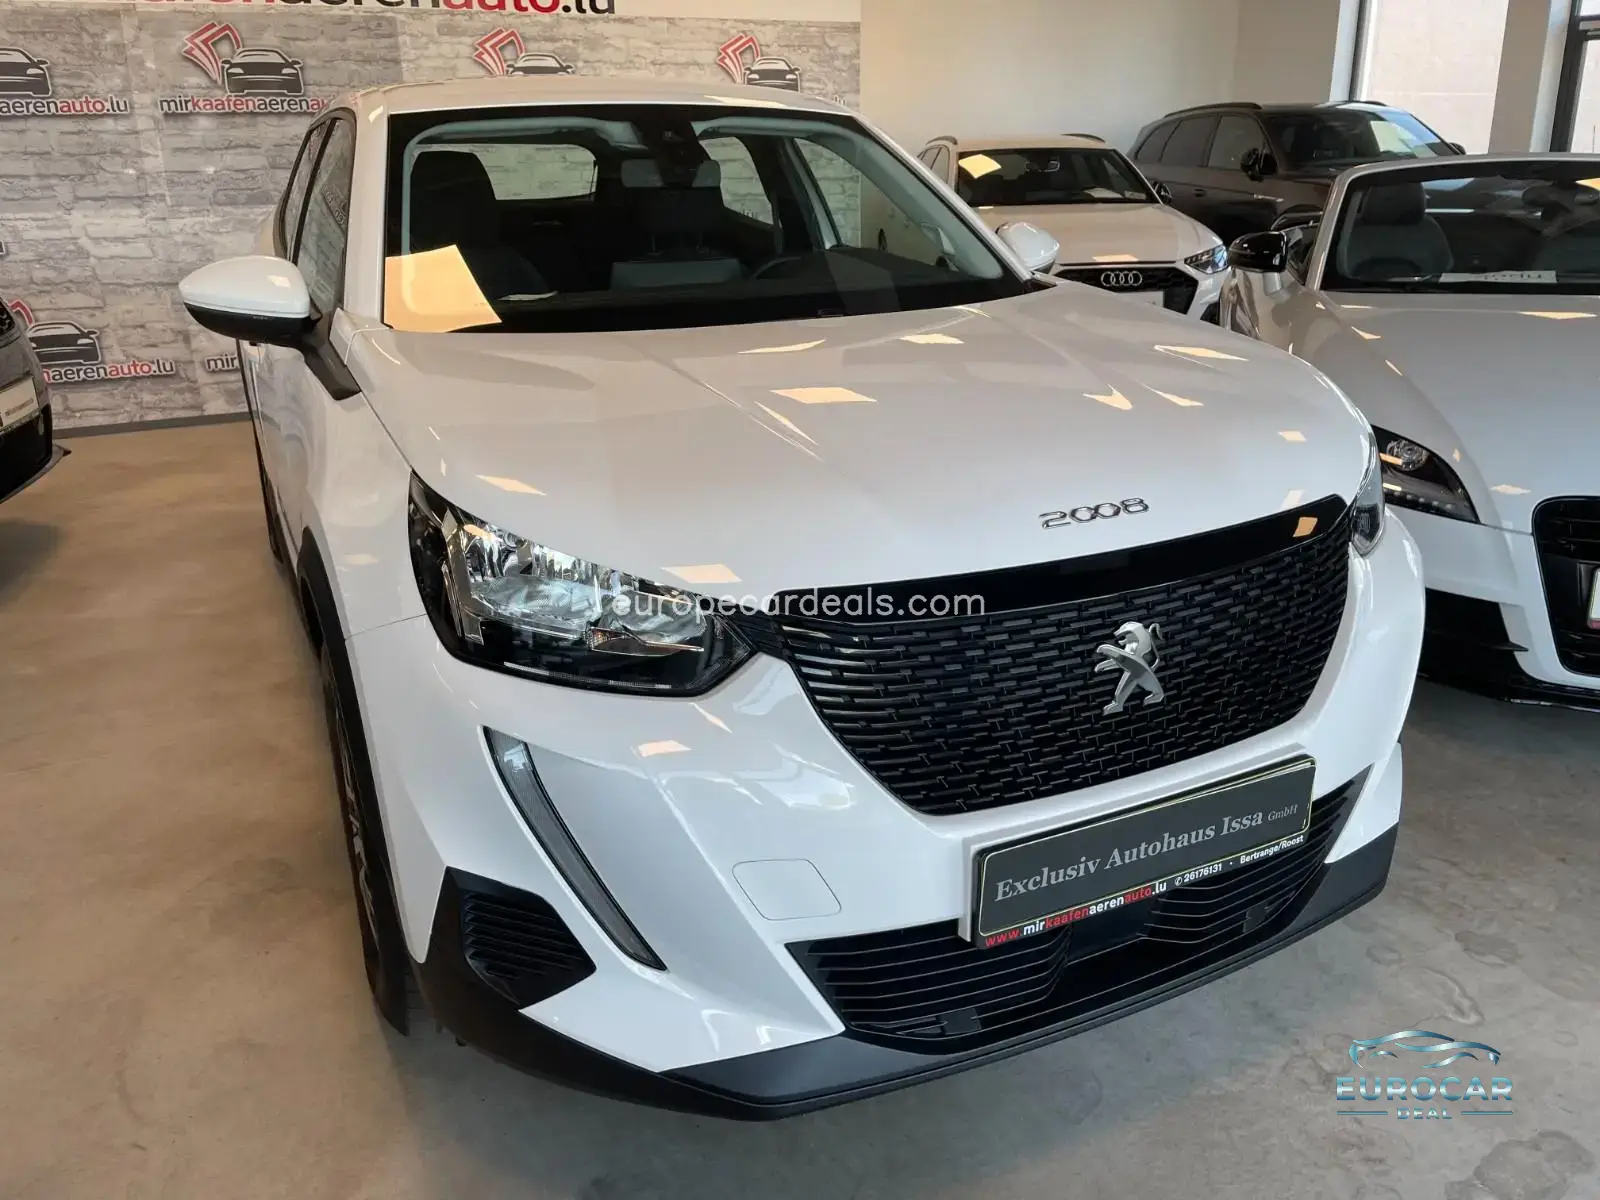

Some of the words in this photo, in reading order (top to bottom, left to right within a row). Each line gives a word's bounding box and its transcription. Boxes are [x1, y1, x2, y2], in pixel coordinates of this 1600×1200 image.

[1039, 497, 1149, 530] 2008
[994, 856, 1101, 902] Exclusiv
[1104, 825, 1216, 870] Autohaus
[1220, 810, 1263, 837] Issa
[1267, 803, 1298, 822] GmbH
[1240, 834, 1304, 864] Bertrange/Roost
